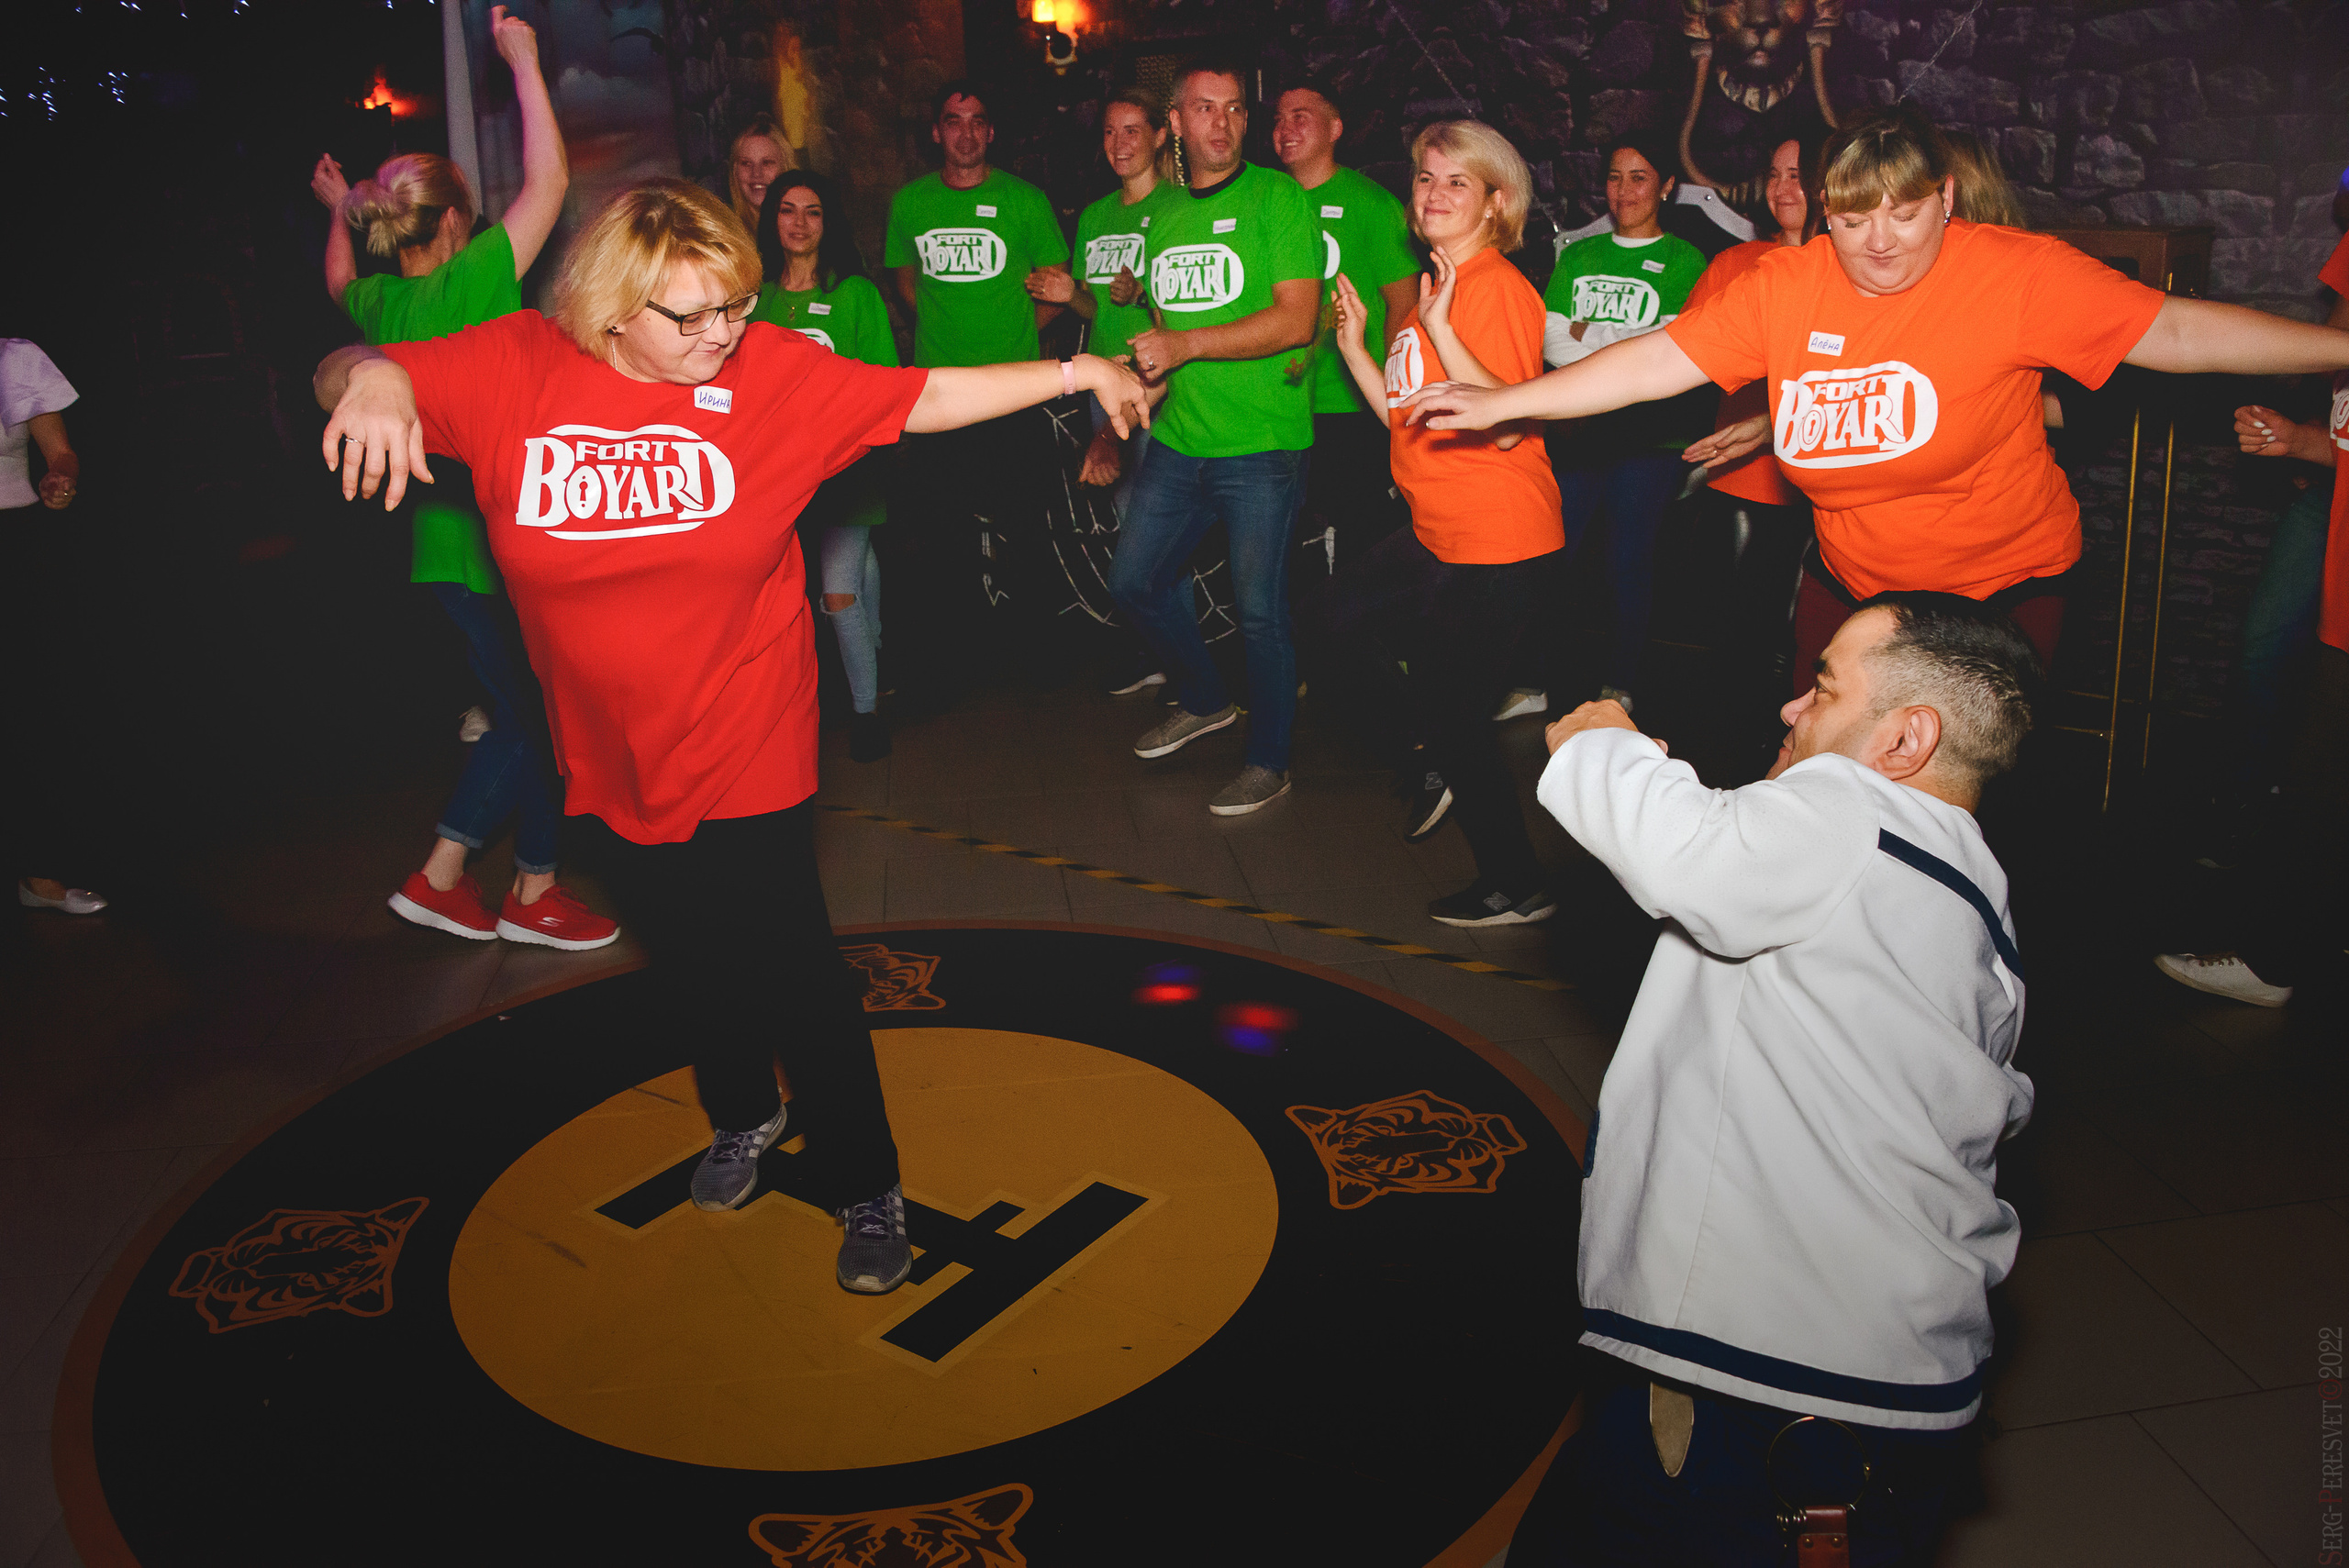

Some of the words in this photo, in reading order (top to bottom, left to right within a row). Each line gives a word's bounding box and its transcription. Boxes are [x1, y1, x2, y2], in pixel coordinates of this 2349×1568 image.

[936, 235, 982, 245] FORT
[1097, 240, 1134, 250] FORT
[915, 233, 1008, 276] BOYARD
[1169, 252, 1216, 268] FORT
[1151, 250, 1244, 306] BOYARD
[1588, 281, 1635, 295] FORT
[1571, 277, 1660, 327] BOYARD
[1813, 375, 1883, 402] FORT
[1774, 365, 1938, 459] BOYARD
[576, 440, 669, 462] FORT
[516, 437, 735, 528] BOYARD
